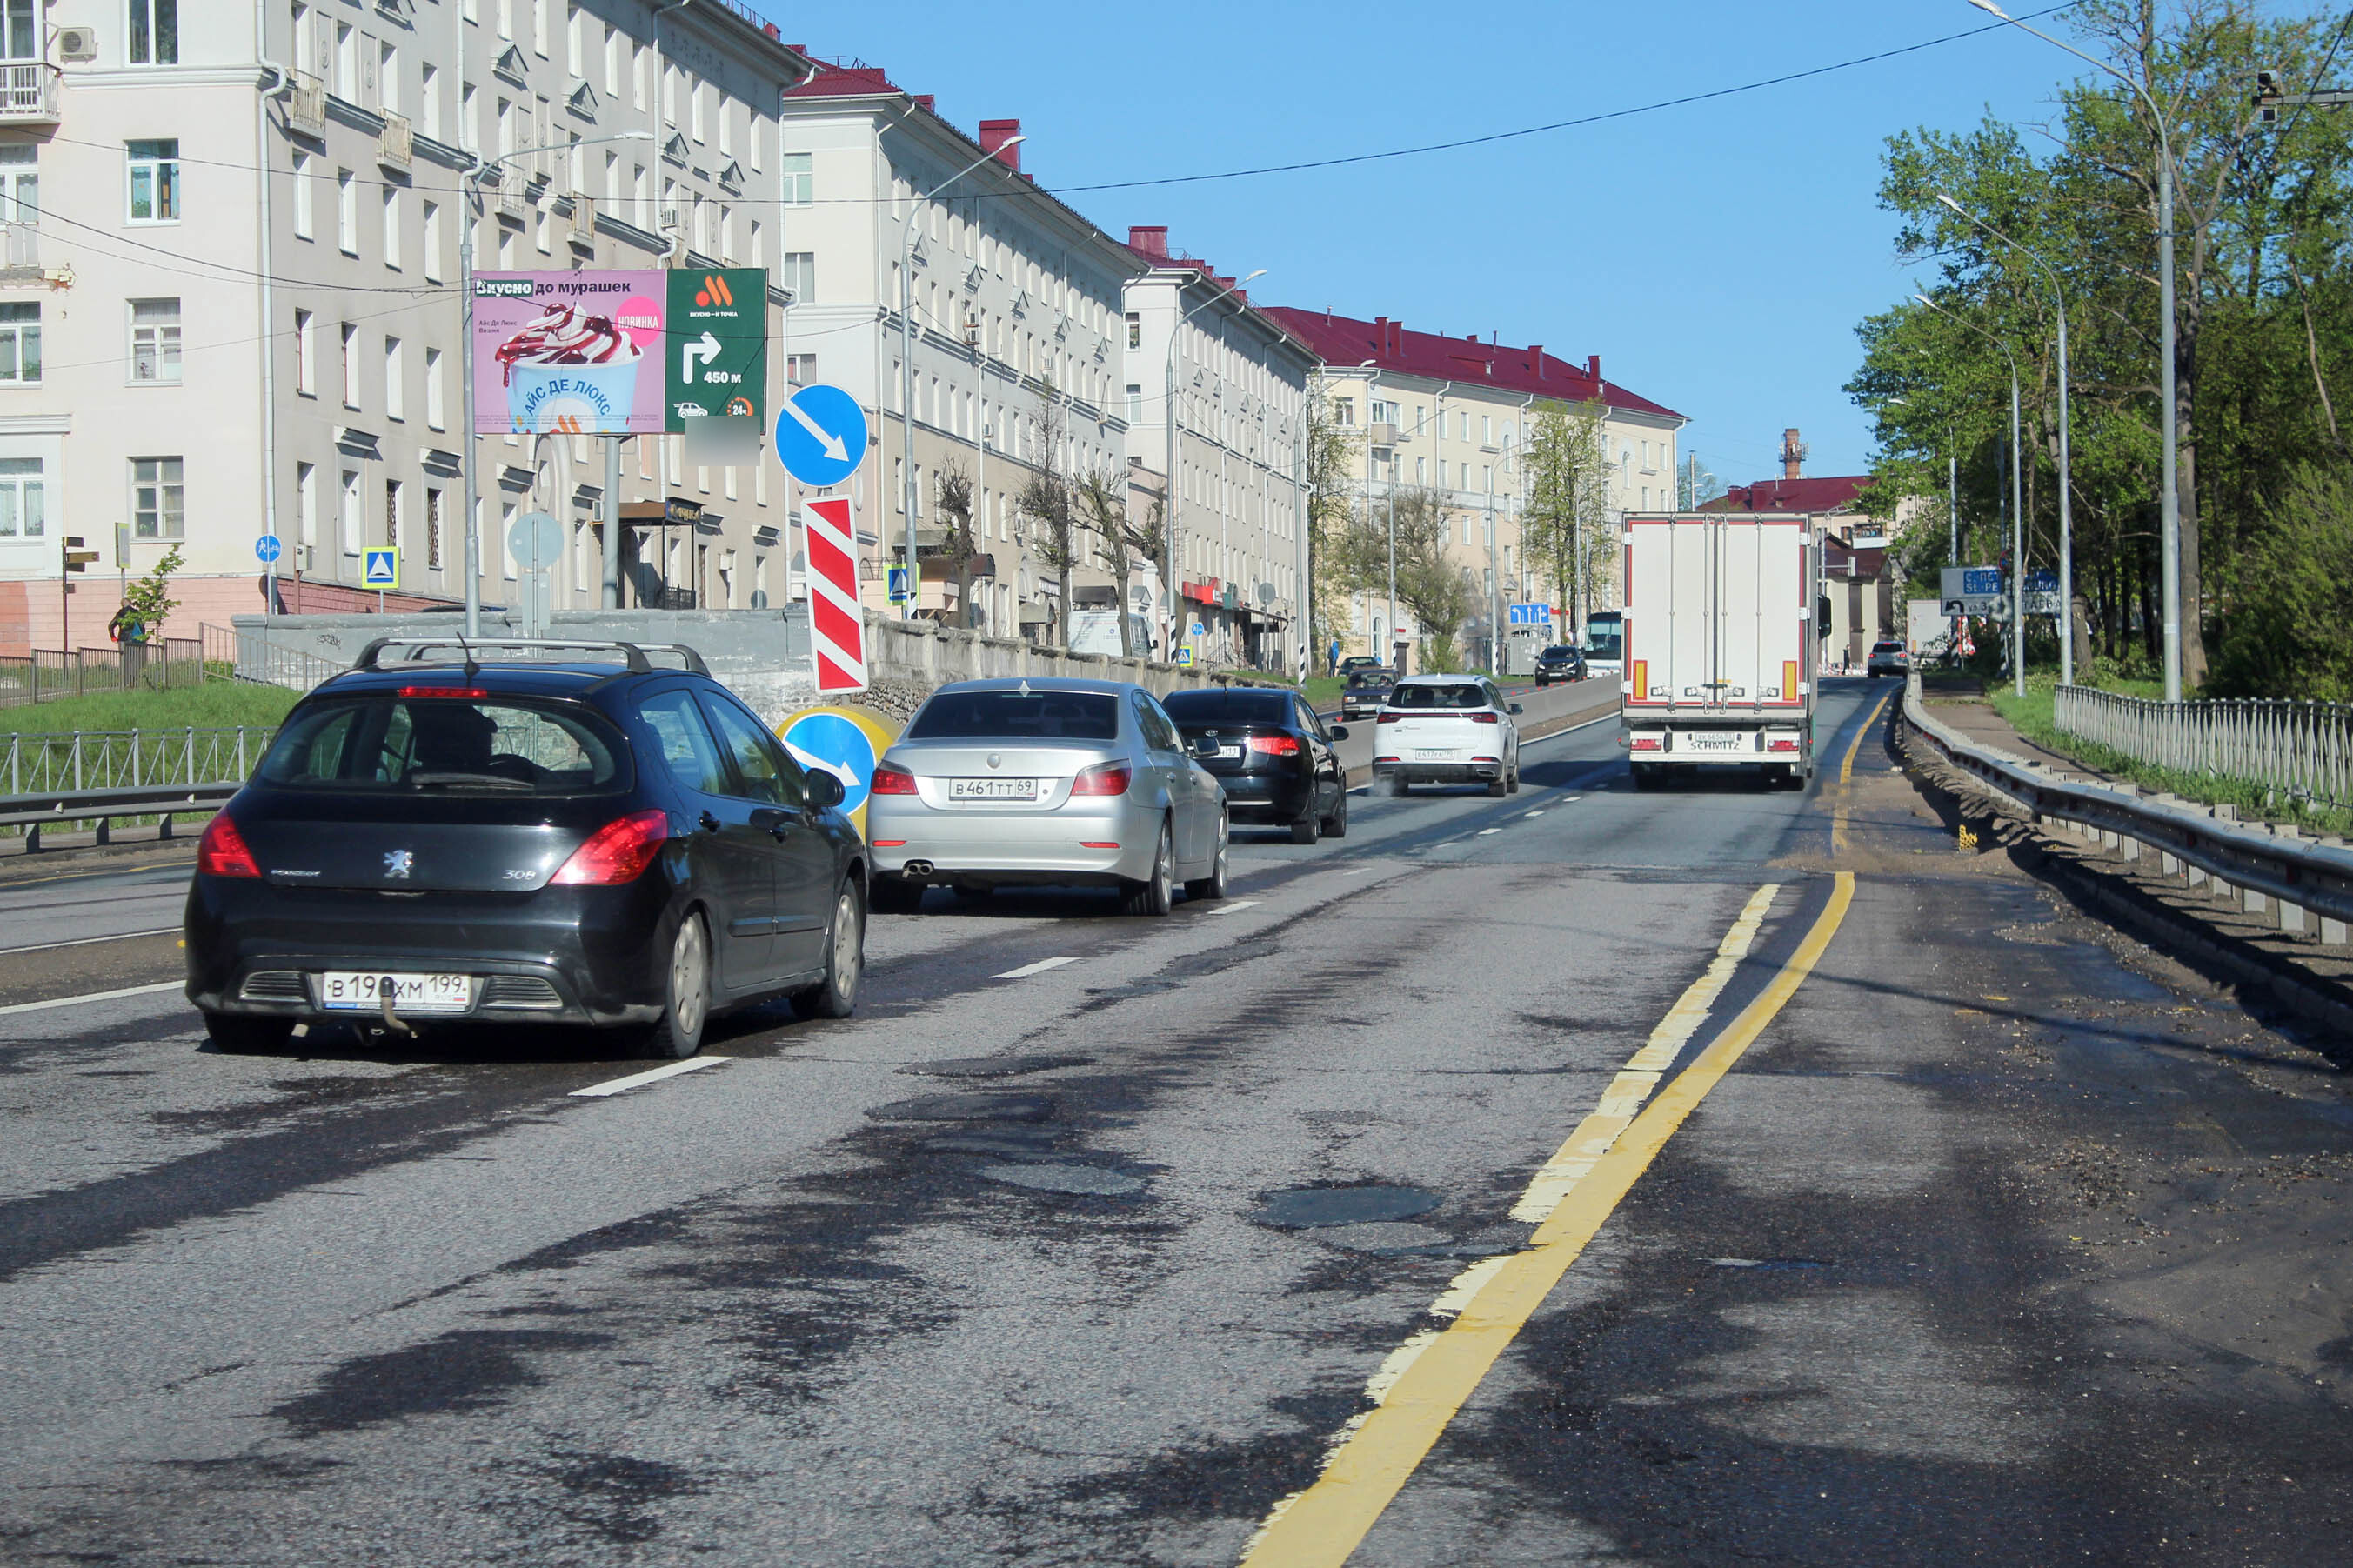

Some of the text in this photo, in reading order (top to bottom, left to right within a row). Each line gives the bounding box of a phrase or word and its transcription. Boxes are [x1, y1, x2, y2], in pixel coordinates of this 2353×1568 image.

[476, 280, 631, 297] Вкусно до мурашек
[618, 315, 658, 329] НОВИНКА
[704, 372, 728, 384] 450
[525, 379, 611, 416] АЙС ДЕ ЛЮКС
[1690, 741, 1740, 750] SCHMITZ
[956, 780, 1032, 795] В461ТТ 69
[502, 870, 536, 880] 308
[332, 975, 463, 998] В19ХМ 199
